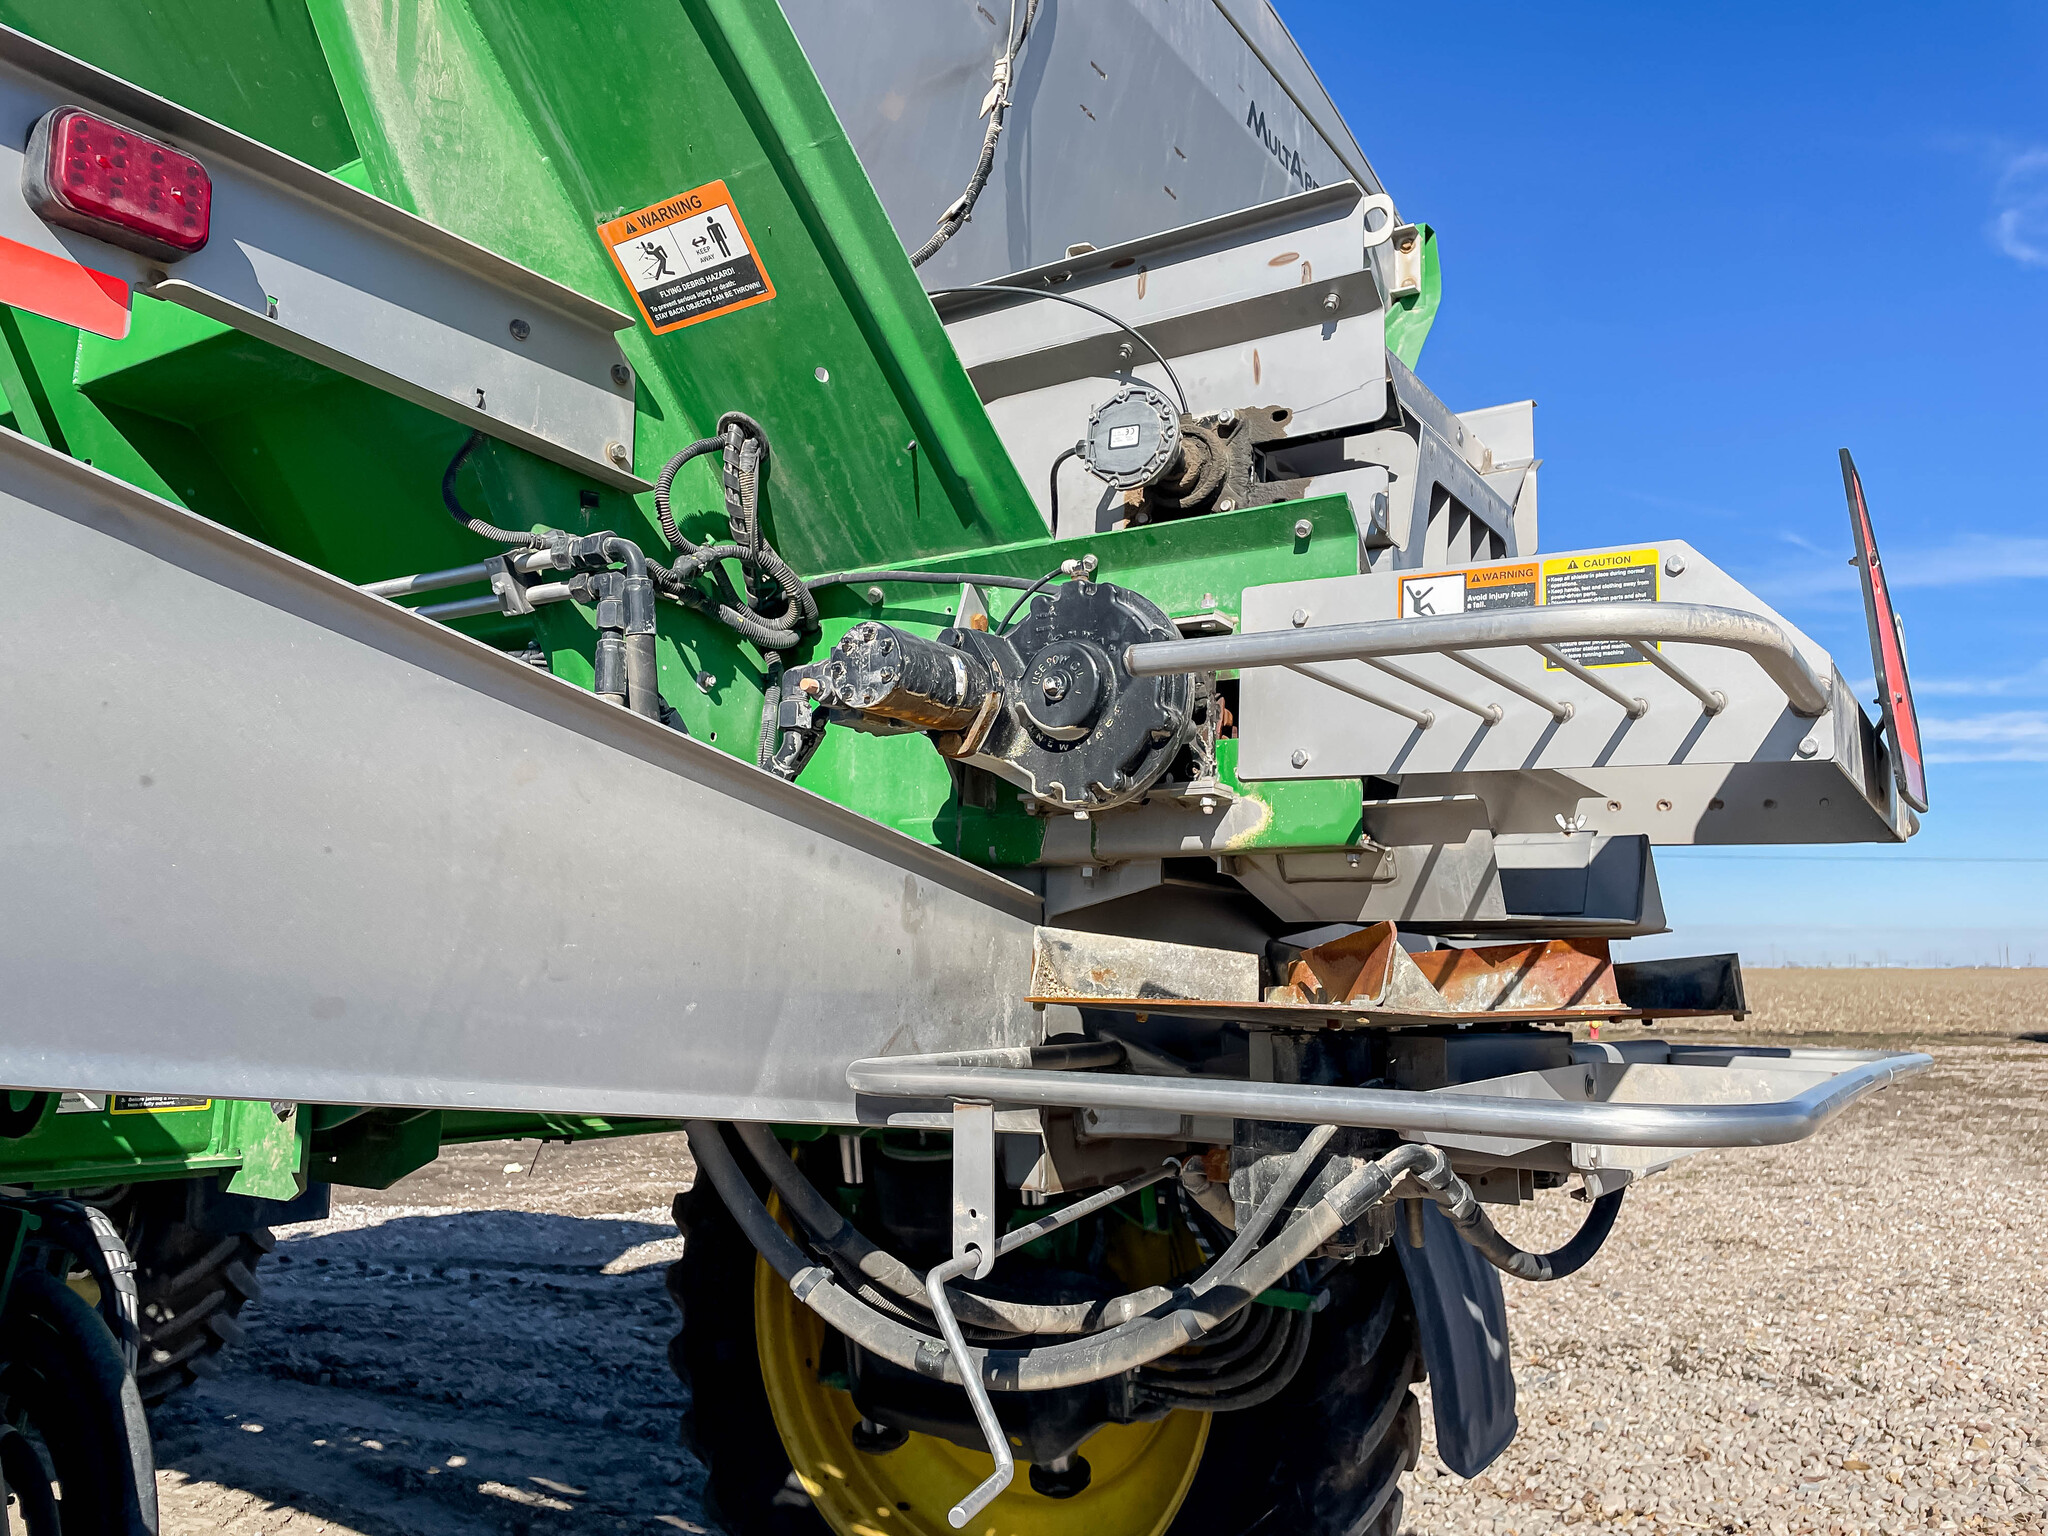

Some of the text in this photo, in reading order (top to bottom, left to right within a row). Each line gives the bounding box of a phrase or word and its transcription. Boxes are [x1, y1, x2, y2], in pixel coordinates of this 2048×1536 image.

[1246, 100, 1320, 192] MULTAP
[637, 195, 702, 229] WARNING
[695, 246, 711, 255] KEEP
[700, 254, 715, 264] AWAY
[659, 267, 736, 299] FLYING DEBRIS HAZARD!
[650, 305, 659, 313] To
[658, 299, 678, 312] prevent
[677, 293, 697, 304] serious
[712, 285, 719, 293] or
[719, 280, 737, 290] death:
[654, 311, 669, 321] STAY
[668, 305, 687, 317] BACK!
[685, 297, 712, 311] OBJECTS
[711, 293, 725, 303] CAN
[724, 290, 734, 299] BE
[732, 280, 762, 295] THROWN!
[1583, 555, 1631, 568] CAUTION
[1482, 568, 1534, 581] WARNING
[1595, 571, 1609, 579] place
[1467, 593, 1488, 602] Avoid
[1511, 590, 1528, 598] from
[1623, 592, 1635, 600] and
[1472, 601, 1487, 609] fall.
[1602, 649, 1625, 657] machine
[1031, 663, 1047, 686] USE
